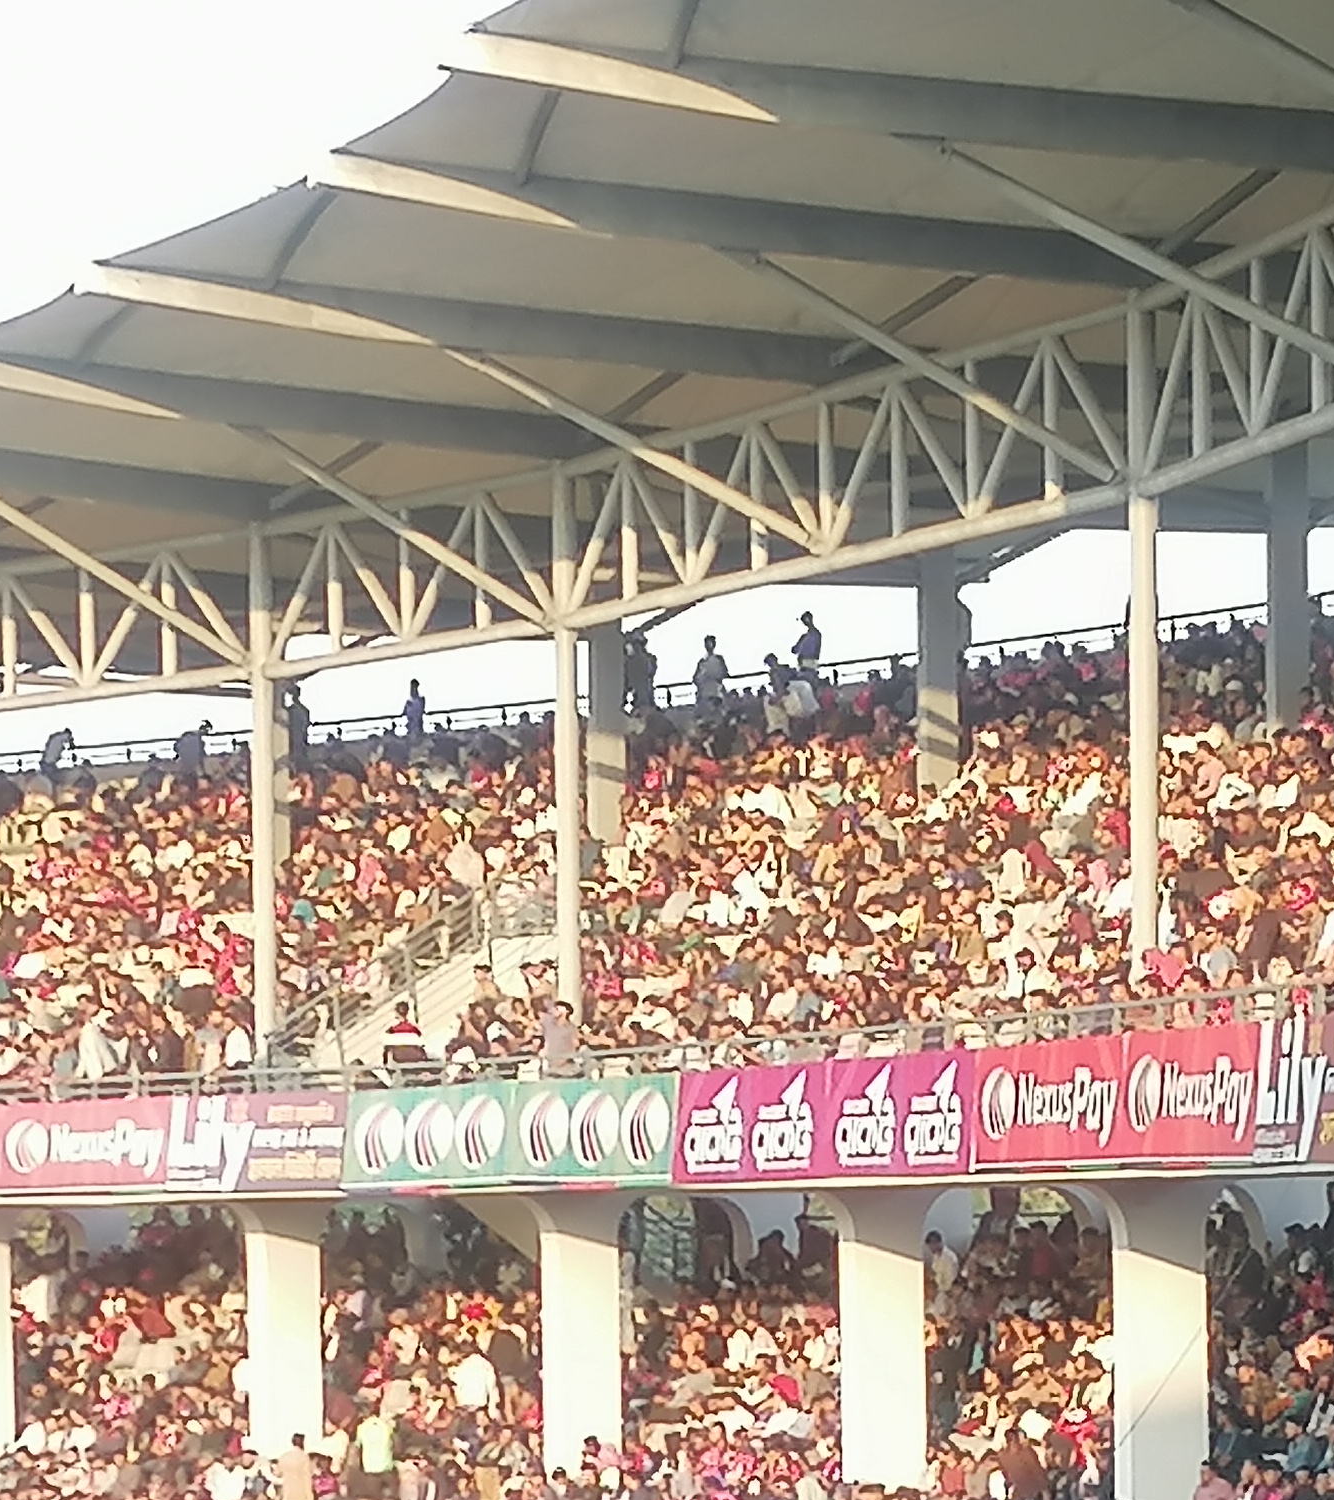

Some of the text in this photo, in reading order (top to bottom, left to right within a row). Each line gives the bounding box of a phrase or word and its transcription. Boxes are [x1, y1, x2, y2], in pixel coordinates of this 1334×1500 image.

[1017, 1067, 1117, 1148] NexusPay
[1162, 1055, 1254, 1142] NexusPay
[1256, 1005, 1327, 1162] Lily
[50, 1117, 166, 1179] NexusPay
